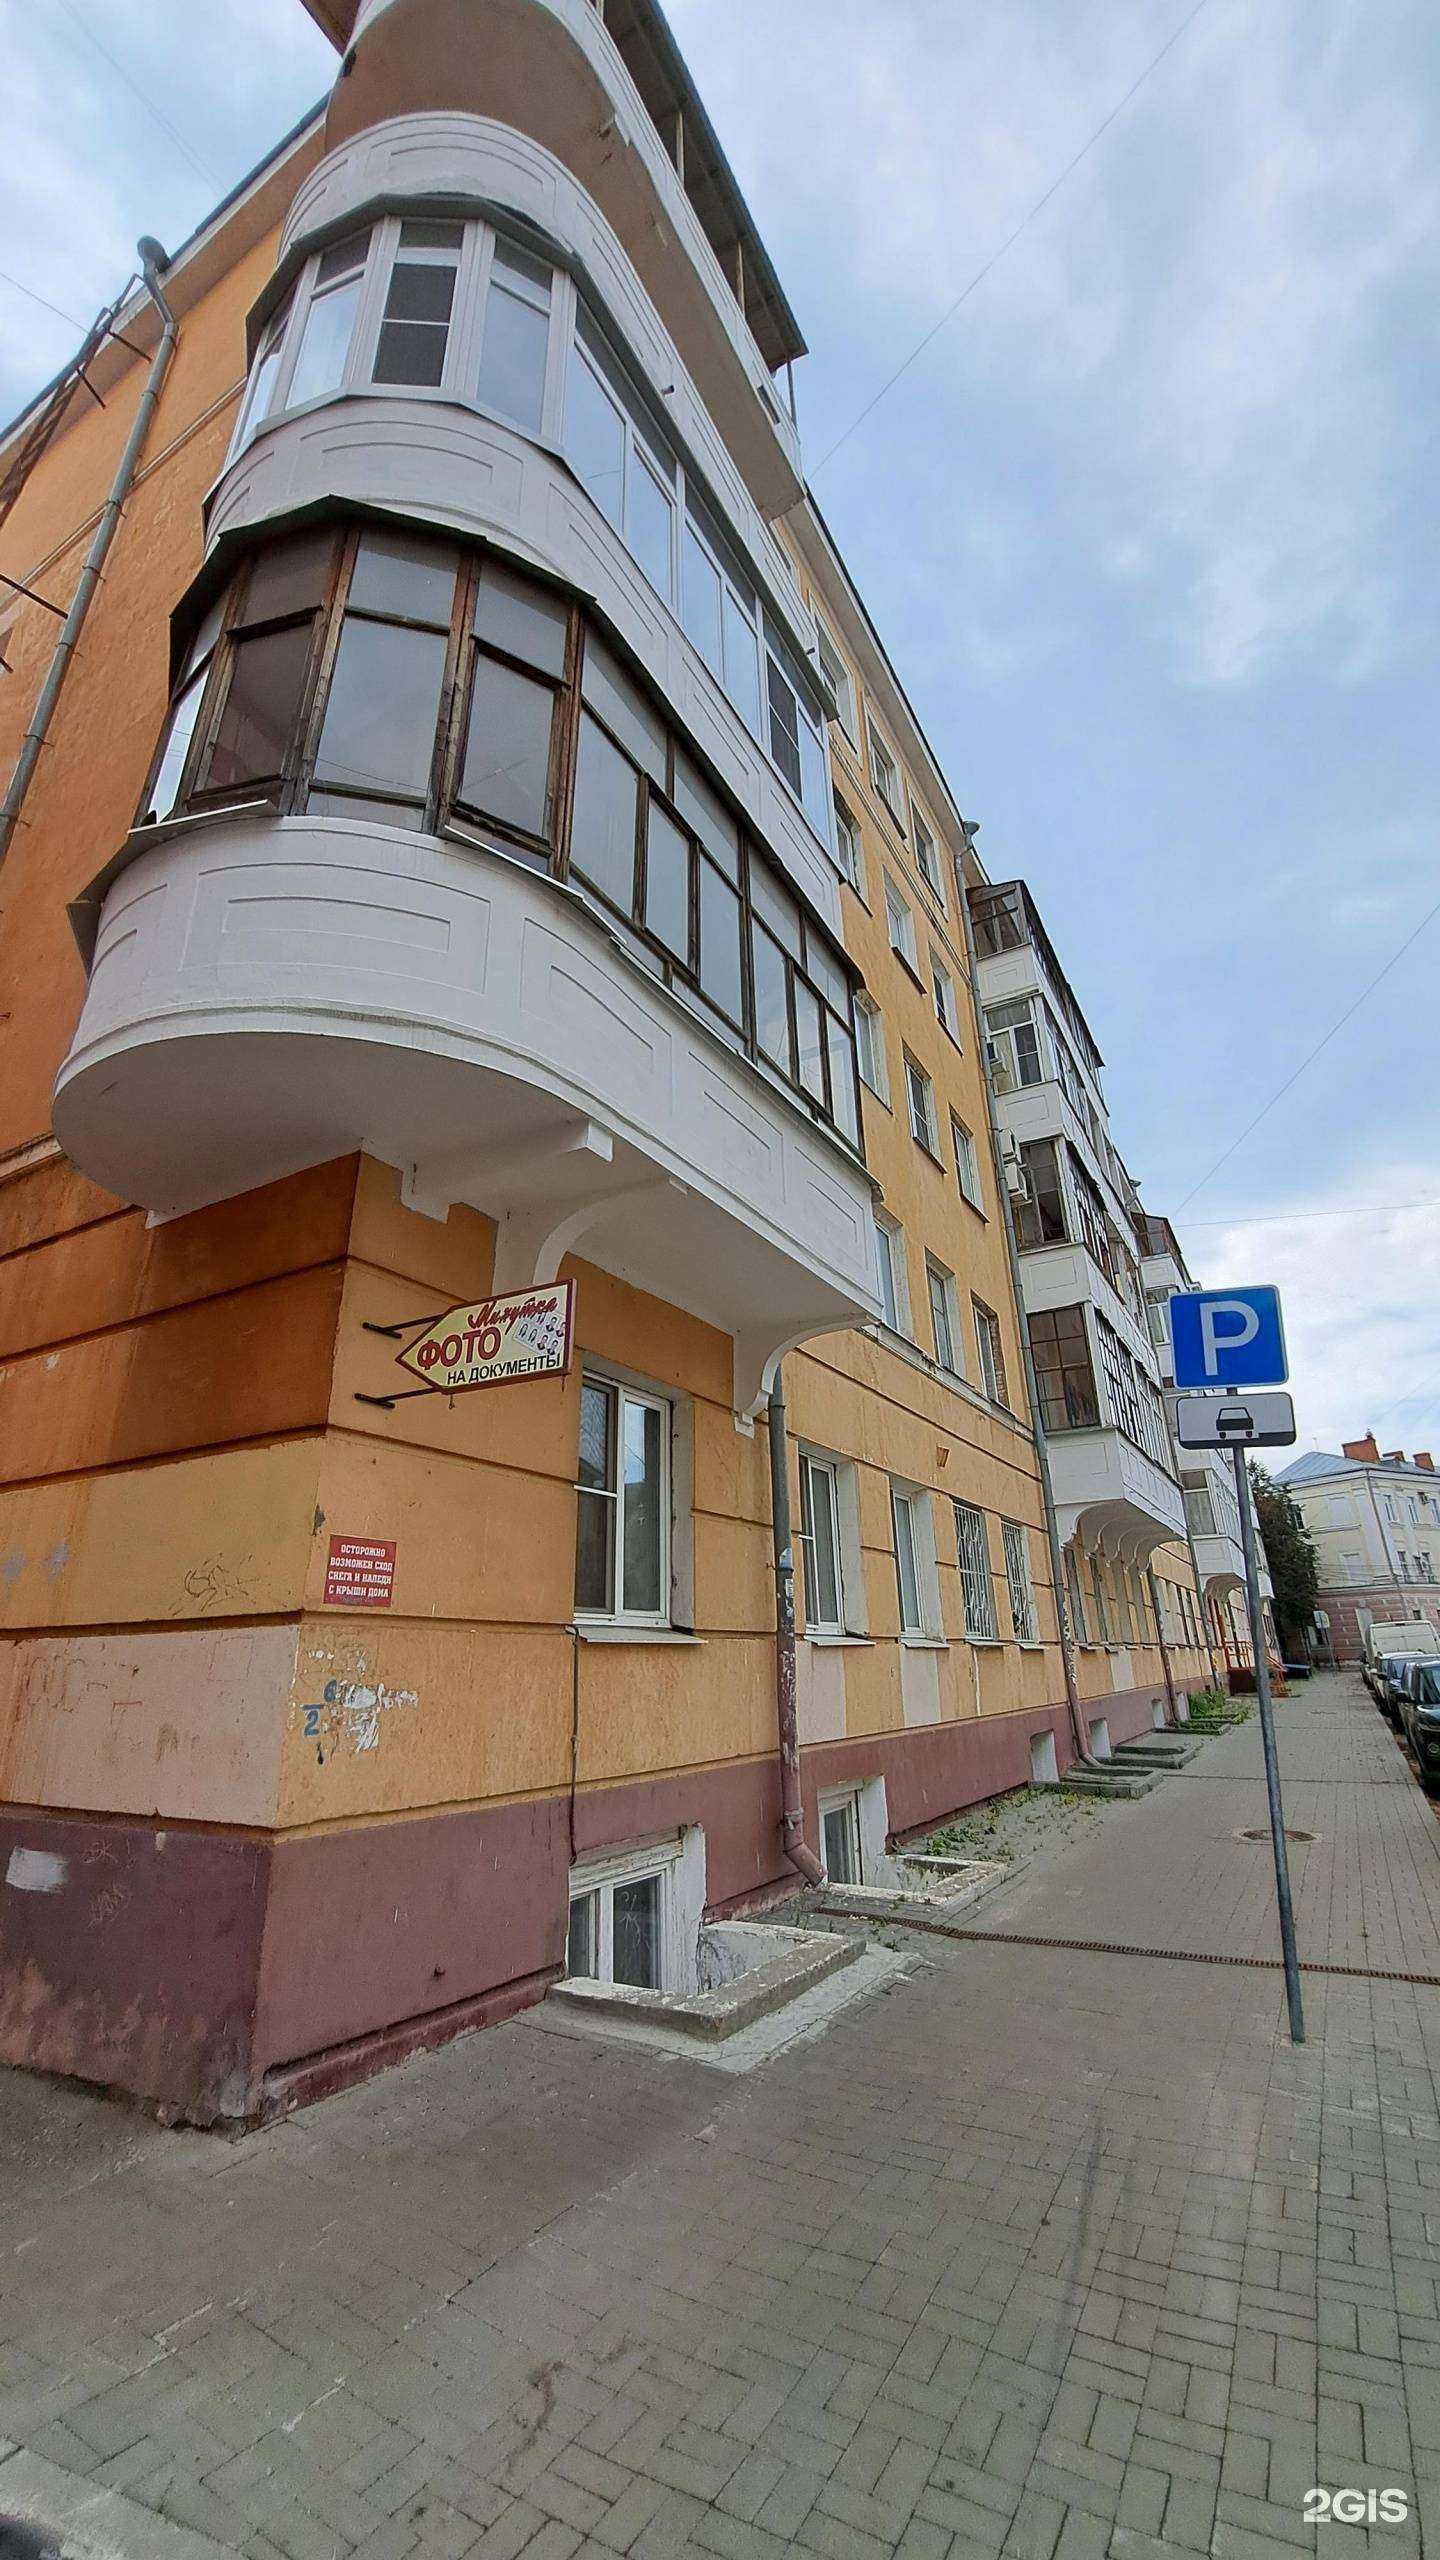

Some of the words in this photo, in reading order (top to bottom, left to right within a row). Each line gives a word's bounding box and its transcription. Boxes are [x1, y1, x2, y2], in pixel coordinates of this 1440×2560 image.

[468, 1297, 558, 1335] Минутка
[417, 1326, 502, 1371] ФОТО
[1200, 1300, 1259, 1376] P
[447, 1369, 466, 1385] НА
[469, 1353, 561, 1384] ДОКУМЕНТЫ
[341, 1544, 386, 1557] ОСТОРОЖНО
[330, 1557, 373, 1569] ВОЗМОЖЕН
[375, 1561, 393, 1572] СХОД
[328, 1571, 352, 1581] СНЕГА
[354, 1573, 360, 1582] И
[362, 1574, 392, 1585] НАЛЕДИ
[329, 1585, 334, 1594] С
[336, 1585, 367, 1596] КРЫШИ
[368, 1587, 389, 1597] ДОМА
